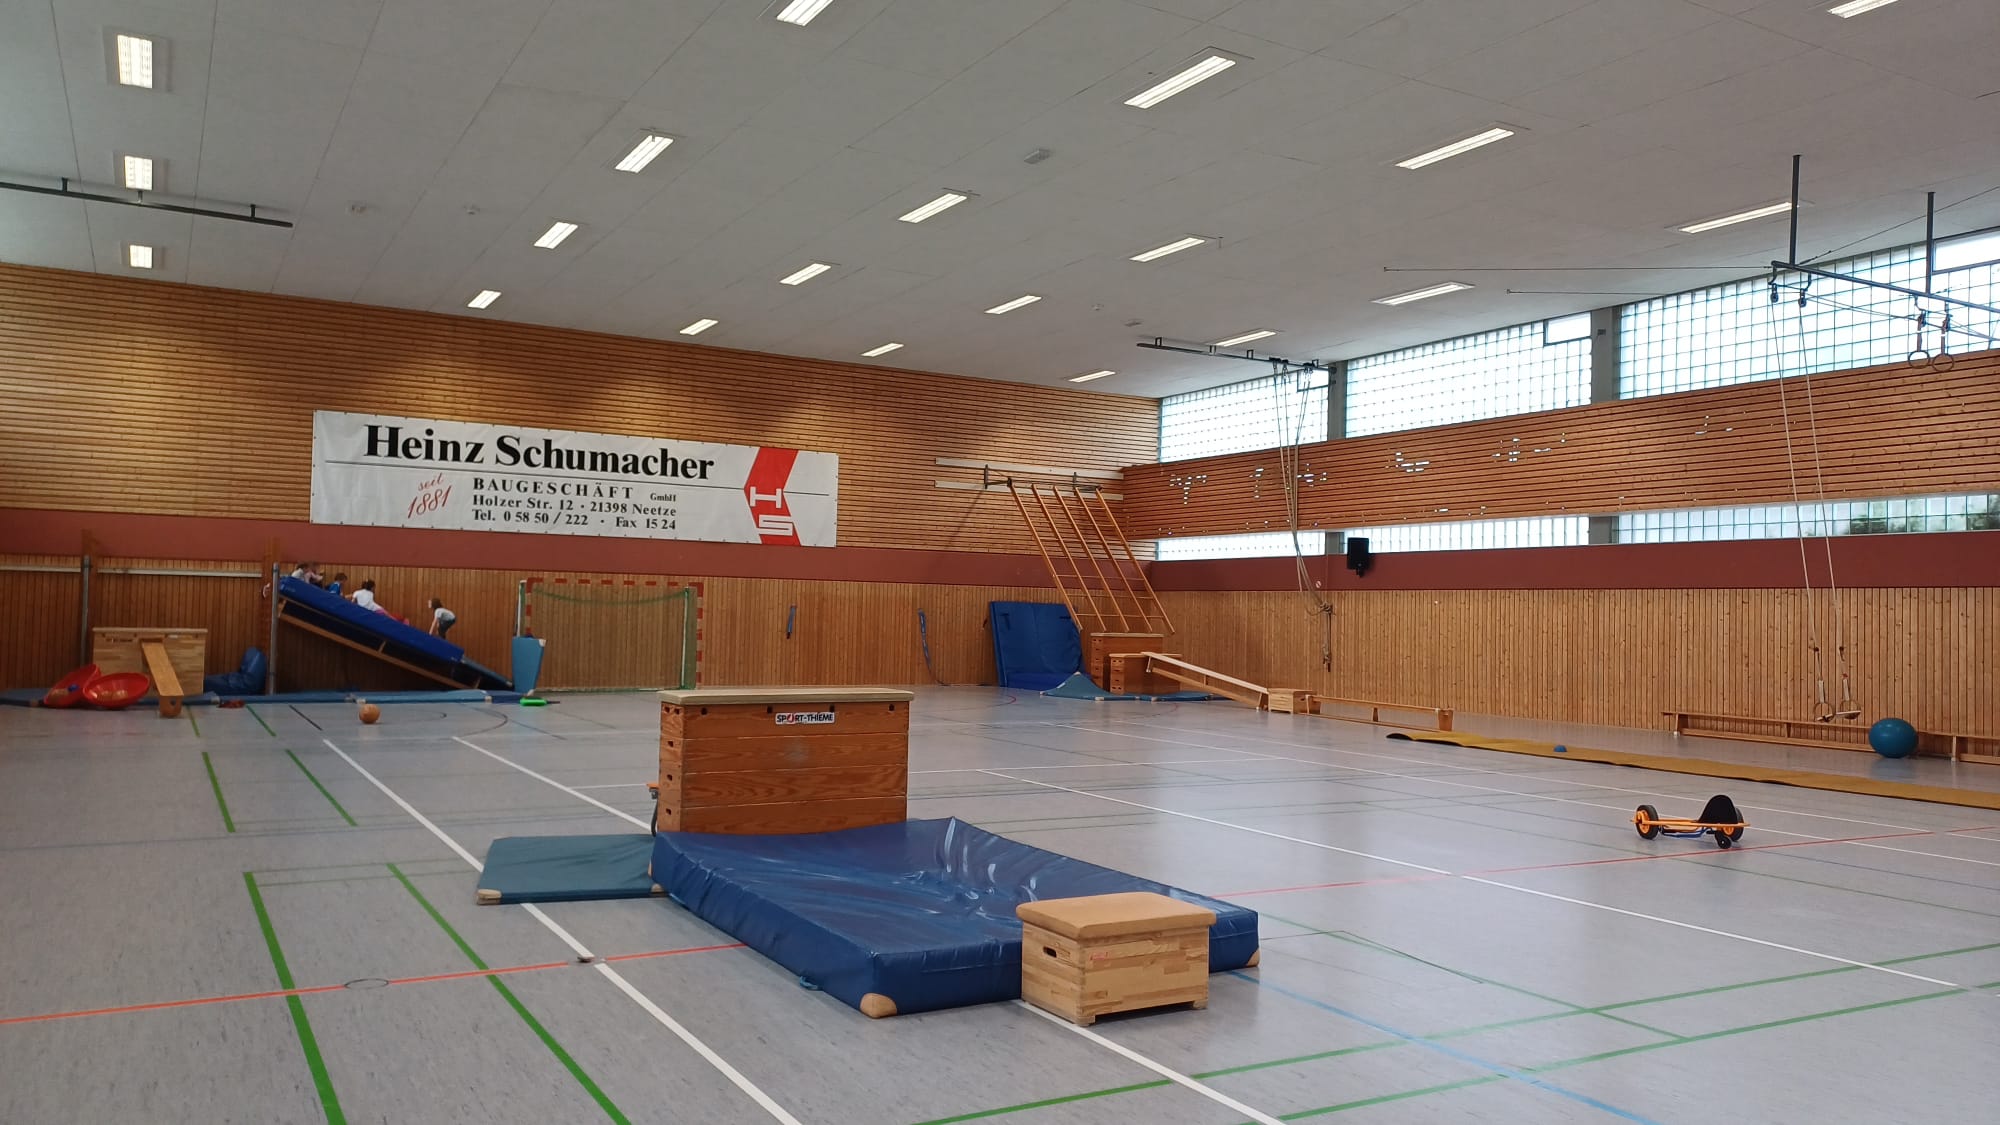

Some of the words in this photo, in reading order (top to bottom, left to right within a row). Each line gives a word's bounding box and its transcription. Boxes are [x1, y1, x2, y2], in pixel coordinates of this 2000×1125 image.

[364, 424, 485, 464] Heinz
[495, 435, 714, 480] Schumacher
[418, 472, 443, 491] seit
[473, 477, 633, 499] BAUGESCHÄFT
[650, 492, 677, 502] GmbH
[408, 485, 452, 519] 1881
[472, 495, 522, 508] Holzer
[527, 497, 552, 510] Str.
[559, 500, 573, 511] 12
[590, 501, 628, 513] 21398
[632, 505, 677, 517] Neetze
[472, 509, 496, 521] Tel.
[565, 514, 588, 526] 222
[616, 516, 637, 528] Fax
